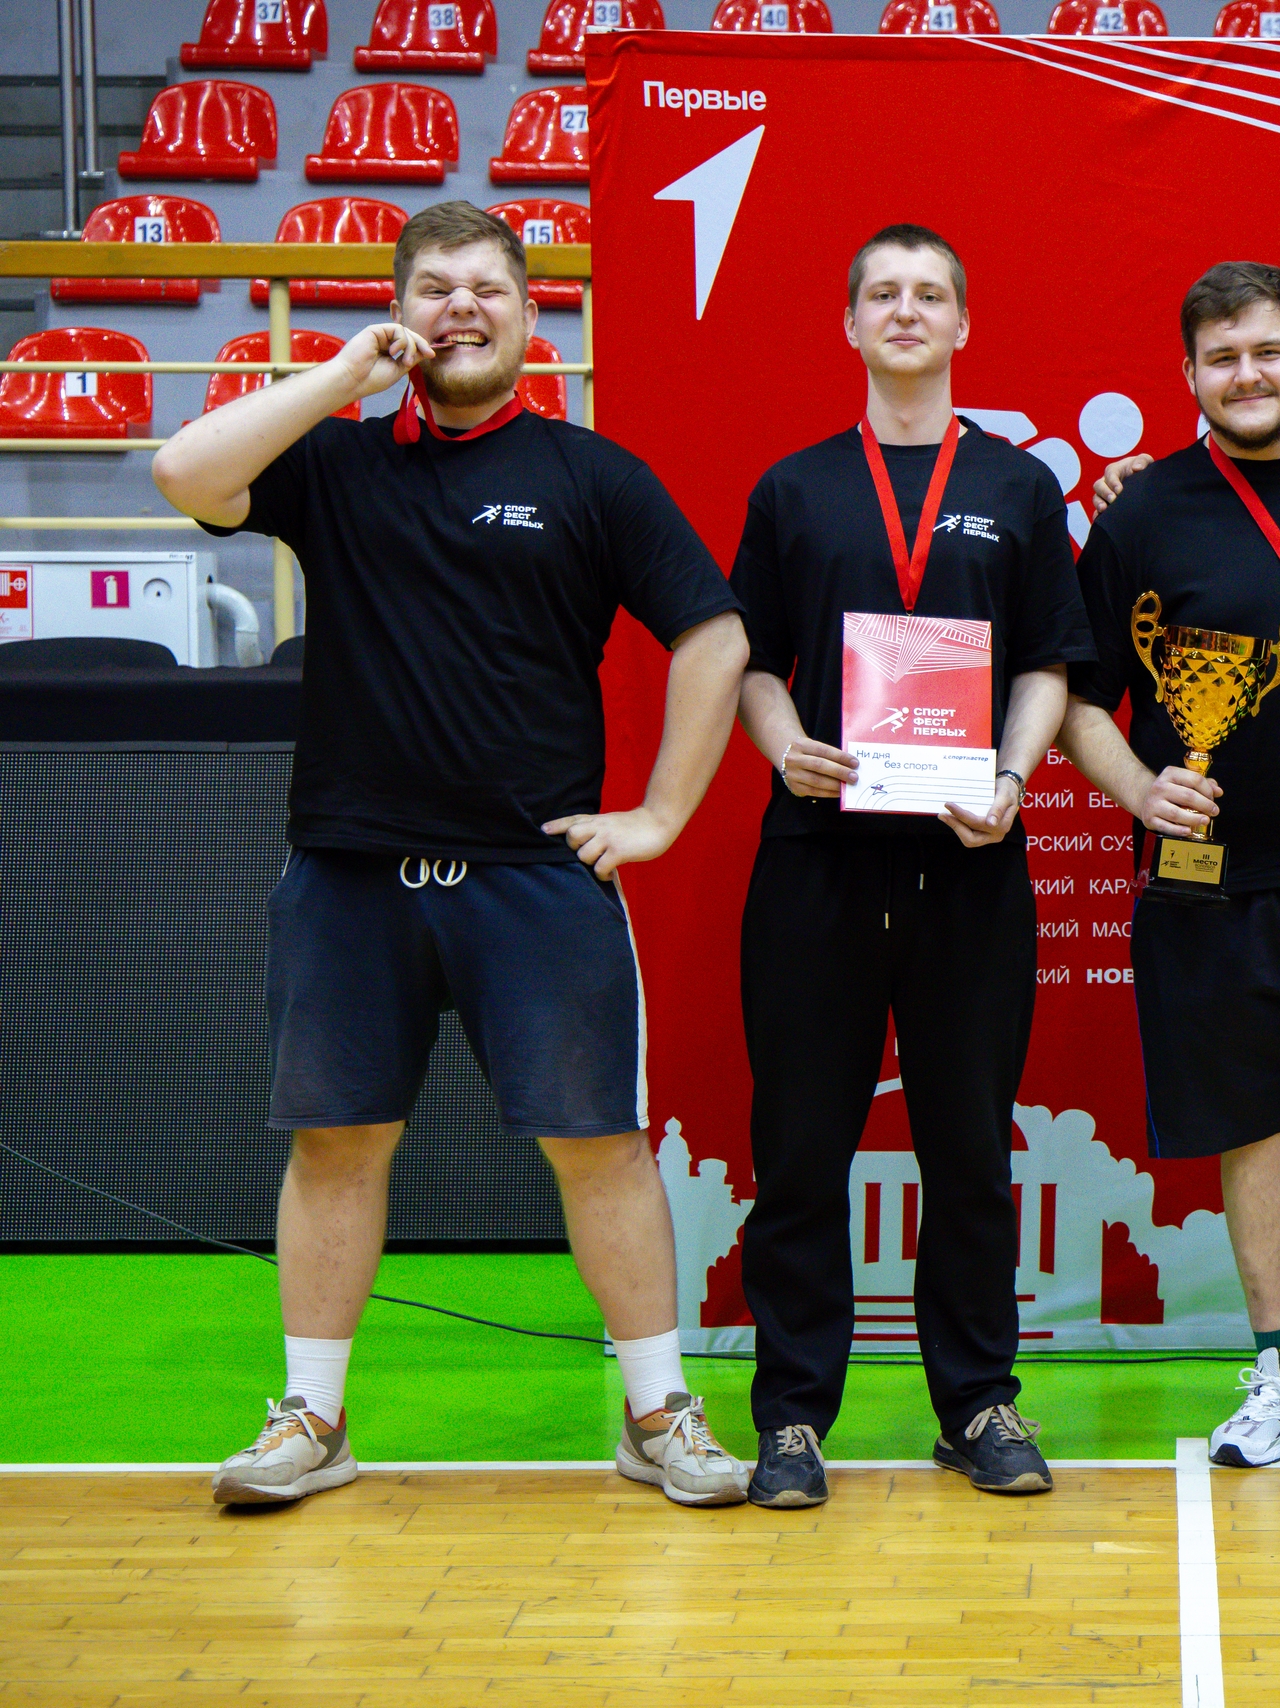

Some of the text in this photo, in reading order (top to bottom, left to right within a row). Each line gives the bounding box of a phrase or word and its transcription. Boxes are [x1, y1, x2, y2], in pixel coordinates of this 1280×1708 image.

[257, 2, 280, 20] 37
[432, 9, 455, 27] 38
[596, 5, 619, 23] 39
[763, 8, 786, 27] 40
[932, 8, 954, 27] 41
[1100, 12, 1123, 30] 42
[643, 80, 767, 118] Первые
[563, 110, 588, 130] 27
[138, 223, 163, 243] 13
[526, 226, 551, 245] 15
[503, 512, 531, 520] ФЕСТ
[504, 505, 537, 514] СПОРТ
[503, 518, 544, 530] ПЕРВЫХ
[963, 521, 989, 531] ФЕСТ
[964, 515, 995, 526] СПОРТ
[963, 528, 1000, 542] ПЕРВЫХ
[913, 707, 956, 717] СПОРТ
[913, 717, 948, 727] ФЕСТ
[913, 727, 967, 737] ПЕРВЫХ
[856, 750, 891, 760] Ни дня
[1046, 749, 1074, 765] БА
[884, 760, 938, 772] без спорта
[1021, 789, 1075, 809] СКИЙ
[1026, 832, 1093, 852] РСКИЙ
[1092, 922, 1132, 939] МАС
[1086, 968, 1134, 985] НОВ
